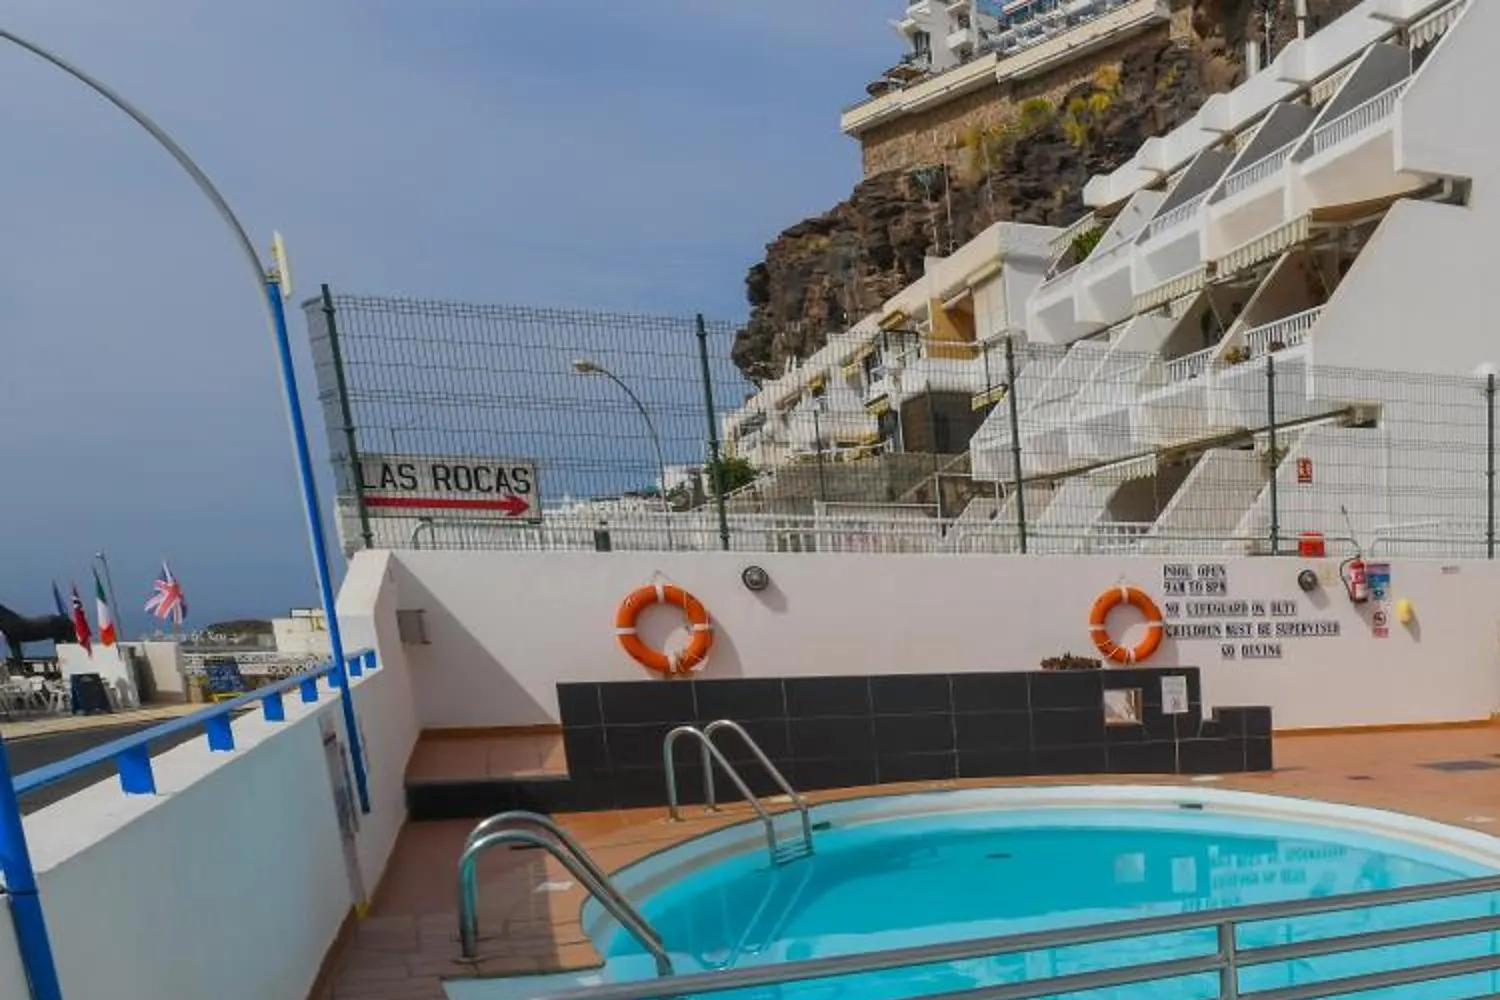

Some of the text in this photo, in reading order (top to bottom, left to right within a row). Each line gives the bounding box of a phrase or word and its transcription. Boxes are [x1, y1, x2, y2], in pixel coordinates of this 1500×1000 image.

[358, 462, 531, 493] LAS ROCAS
[1163, 565, 1226, 578] POOL OPEN
[1164, 580, 1226, 594] 9AM TO 8PM
[1165, 601, 1297, 616] NO LIFEGUARD ON DUTY
[1165, 622, 1340, 638] CHILDREN MUST BE SUPERVISED
[1241, 644, 1282, 658] DIVING
